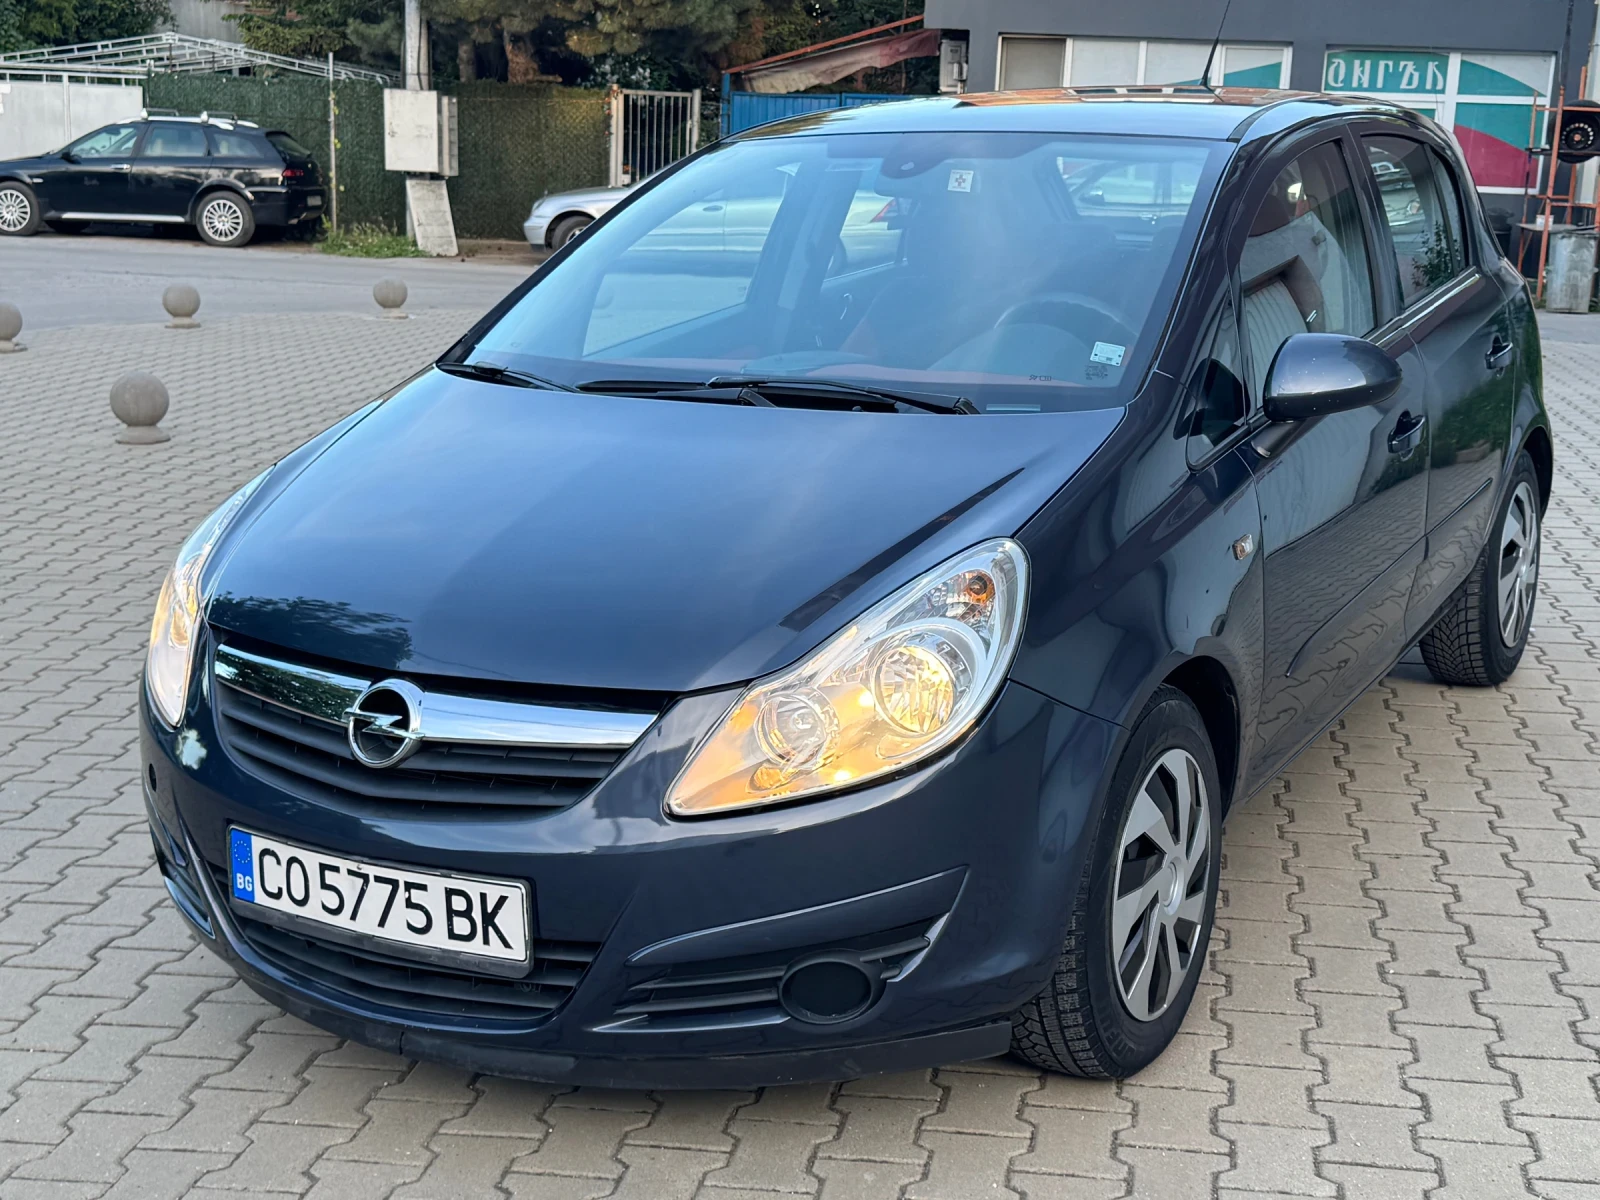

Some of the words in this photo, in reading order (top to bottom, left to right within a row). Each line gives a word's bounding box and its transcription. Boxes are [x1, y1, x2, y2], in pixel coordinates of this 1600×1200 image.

[236, 873, 253, 892] BG
[258, 848, 310, 907] CO
[318, 862, 433, 935] 5775
[444, 886, 514, 949] BK
